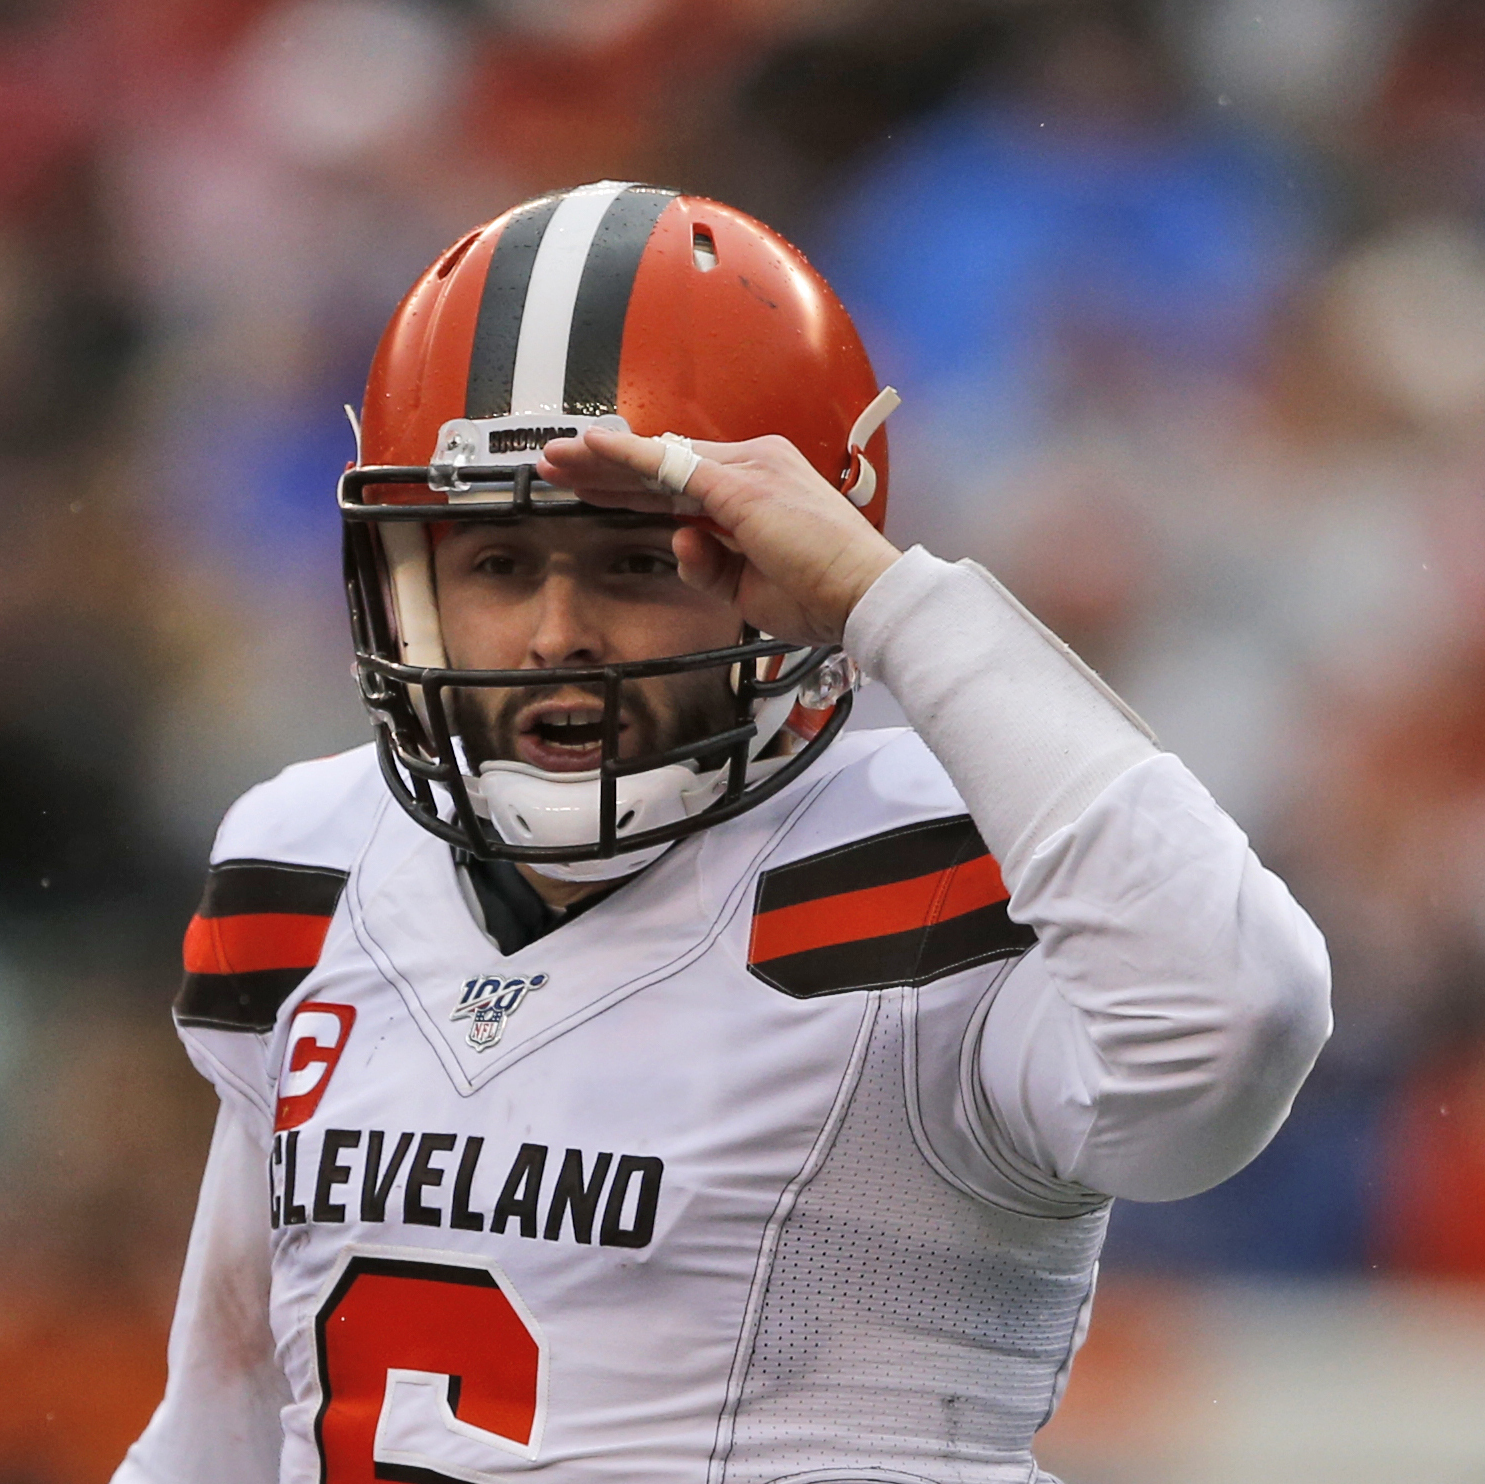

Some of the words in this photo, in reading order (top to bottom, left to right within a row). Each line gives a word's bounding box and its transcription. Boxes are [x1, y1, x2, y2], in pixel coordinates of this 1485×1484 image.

[278, 1010, 343, 1098] C
[472, 1022, 496, 1041] NFL
[270, 1128, 664, 1249] CLEVELAND
